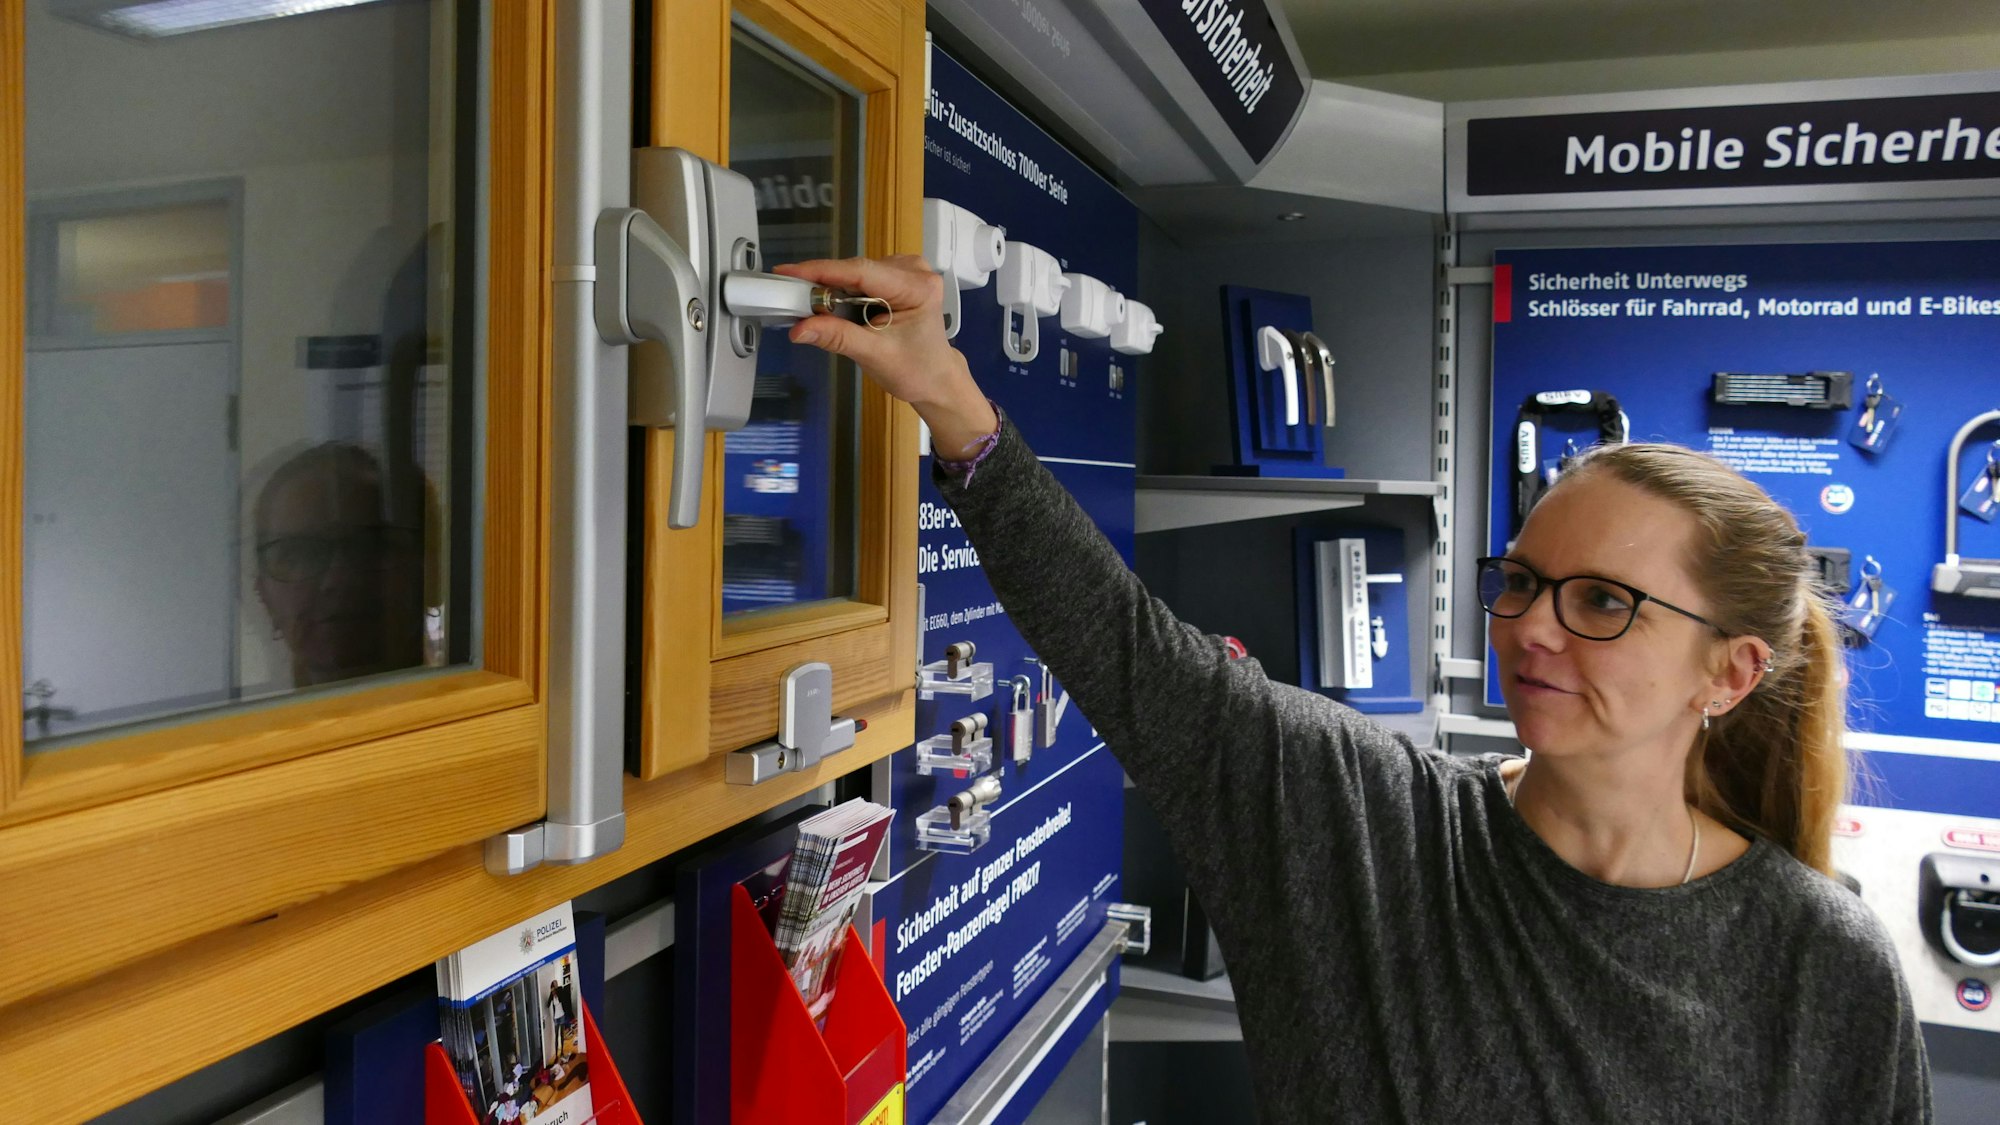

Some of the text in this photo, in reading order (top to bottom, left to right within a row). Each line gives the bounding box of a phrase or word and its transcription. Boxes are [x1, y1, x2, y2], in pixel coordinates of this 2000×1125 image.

[924, 135, 971, 175] Sicher ist sicher!
[929, 88, 1069, 205] ür-Zusatzschloss 7000er Serie
[1565, 127, 1745, 175] Mobile
[1528, 271, 1748, 293] Sicherheit Unterwegs
[1528, 294, 2000, 320] Schlösser für Fahrrad, Motorrad und E-Bikes
[919, 502, 962, 530] 83er-S
[919, 543, 939, 574] Die
[929, 612, 950, 631] EC660,
[950, 611, 963, 626] dem
[963, 605, 986, 625] Zylinder
[986, 602, 996, 616] mit
[896, 801, 1072, 954] Sicherheit auf ganzer Fensterbreite!
[536, 918, 562, 937] POLIZEI
[896, 885, 1011, 1002] Fenster-Panzerriegel
[1011, 861, 1041, 904] FPR217
[920, 1016, 932, 1037] alle
